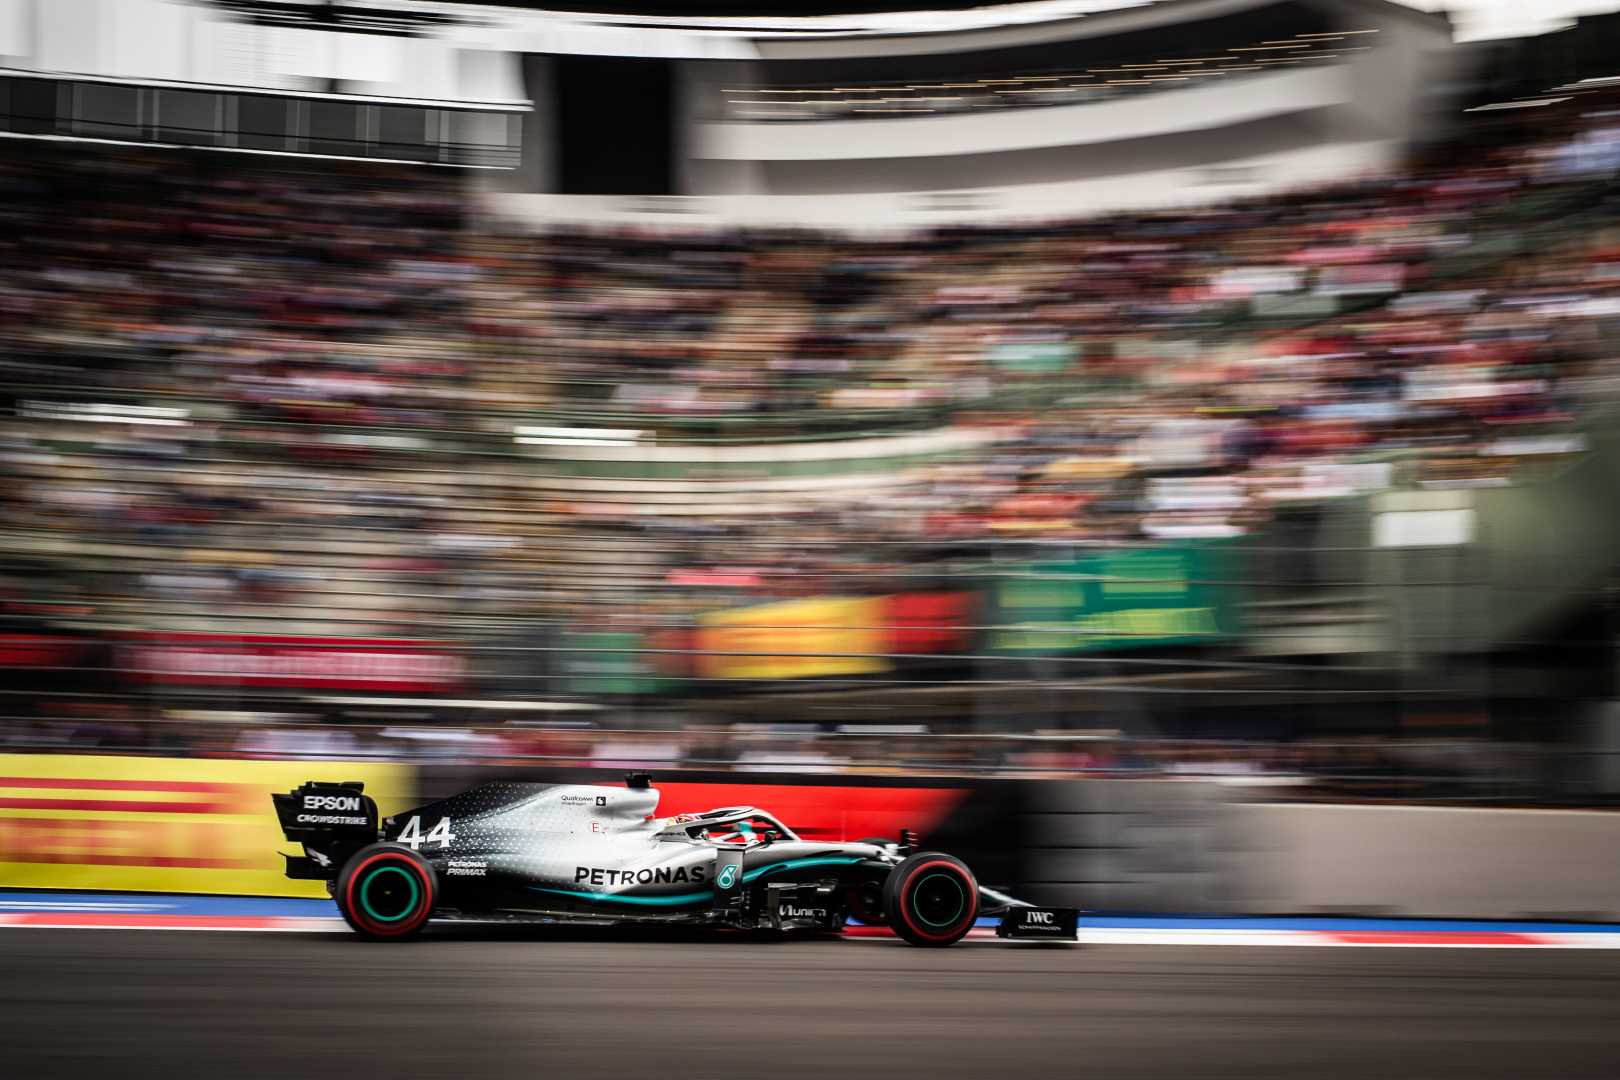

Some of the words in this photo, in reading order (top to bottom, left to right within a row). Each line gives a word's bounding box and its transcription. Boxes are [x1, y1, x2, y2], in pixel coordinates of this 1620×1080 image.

[303, 795, 360, 811] EPSON
[296, 814, 367, 825] CROWDSTRIKE
[396, 815, 456, 850] 44
[592, 822, 599, 833] E
[446, 868, 488, 876] PRIMAX
[574, 866, 705, 886] PETRONAS
[1026, 911, 1054, 924] IWC
